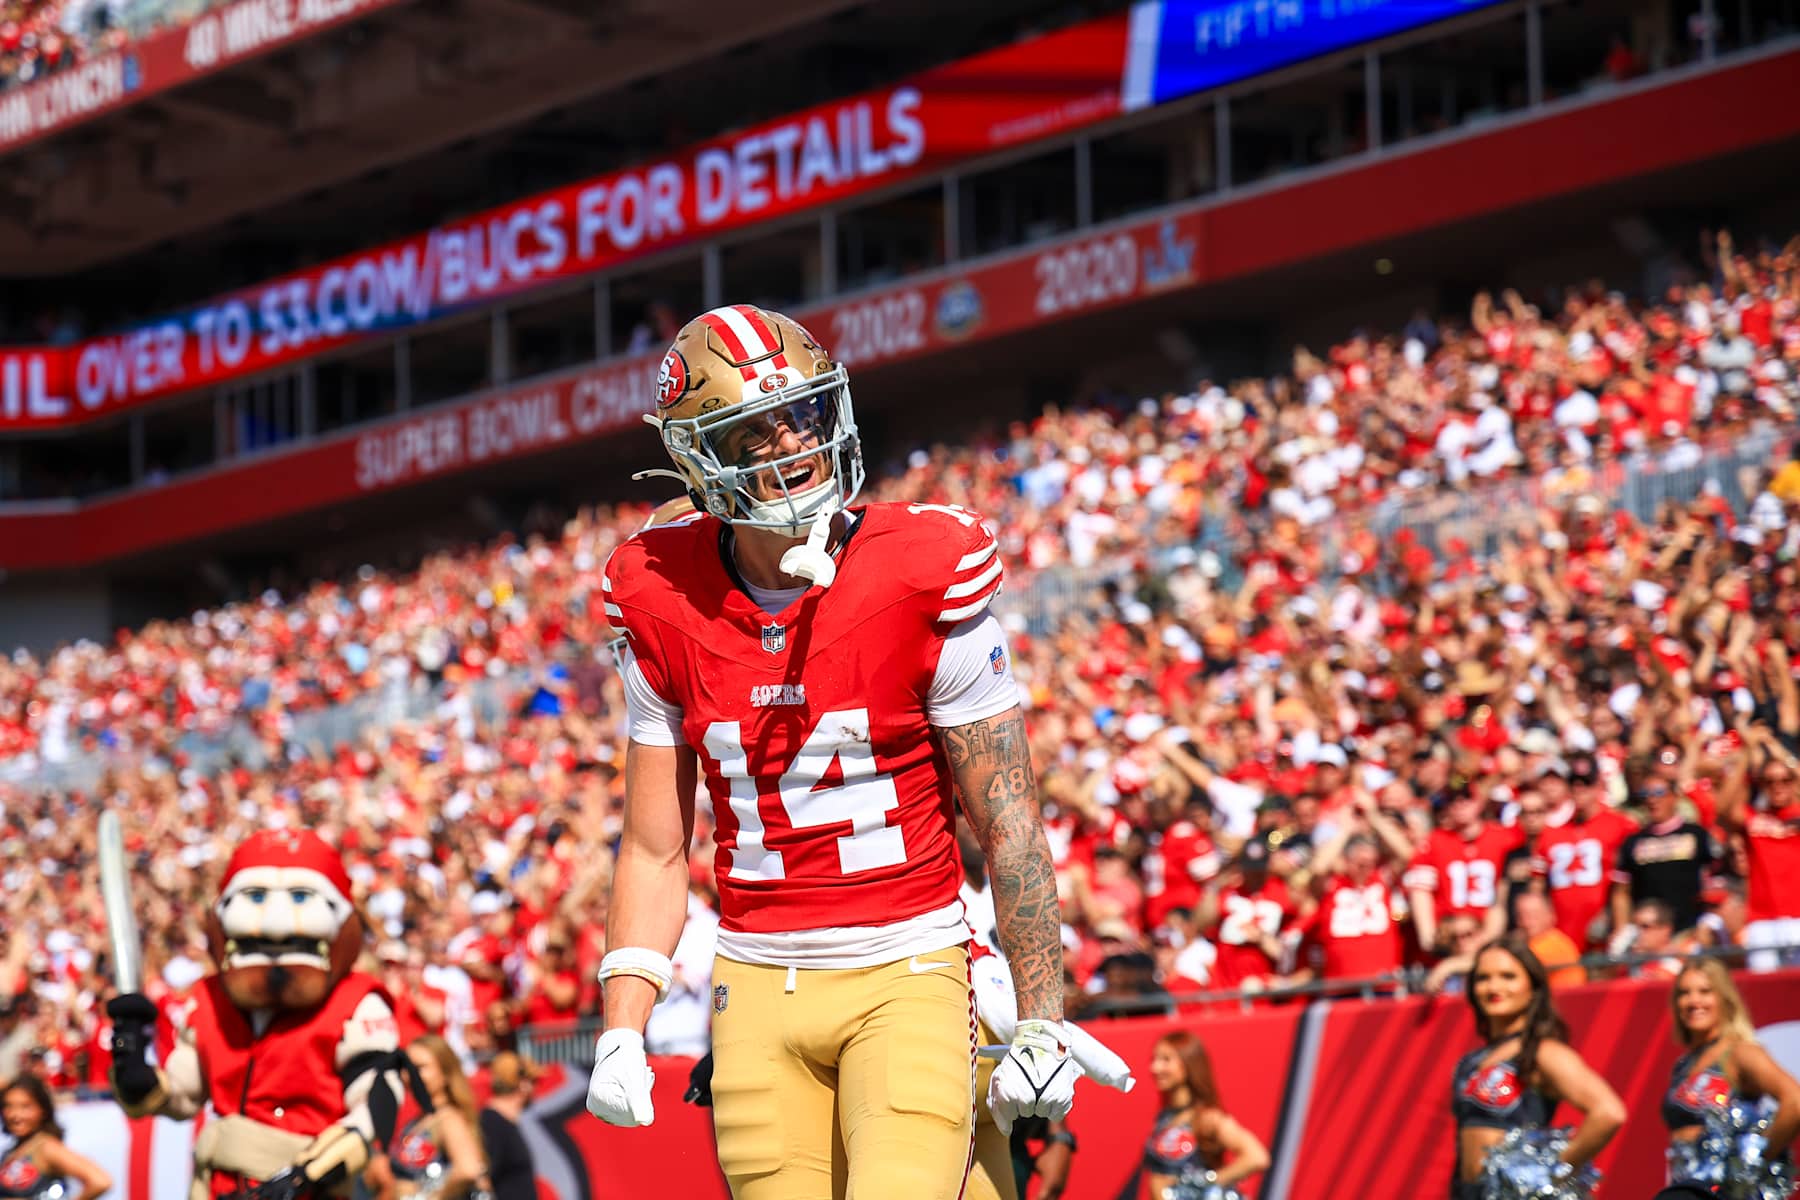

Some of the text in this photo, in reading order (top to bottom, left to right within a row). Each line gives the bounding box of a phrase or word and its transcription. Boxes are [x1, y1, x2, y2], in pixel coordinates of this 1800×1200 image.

[75, 319, 186, 411] OVER
[194, 297, 251, 375] TO
[577, 163, 684, 260] FOR
[695, 86, 926, 226] DETAILS
[1033, 234, 1139, 316] 2020
[830, 288, 926, 368] 2002
[353, 408, 464, 490] SUPER
[467, 388, 568, 461] BOWL
[750, 683, 806, 708] 49ERS
[703, 708, 907, 882] 14
[1446, 858, 1497, 909] 13
[1548, 838, 1603, 890] 23
